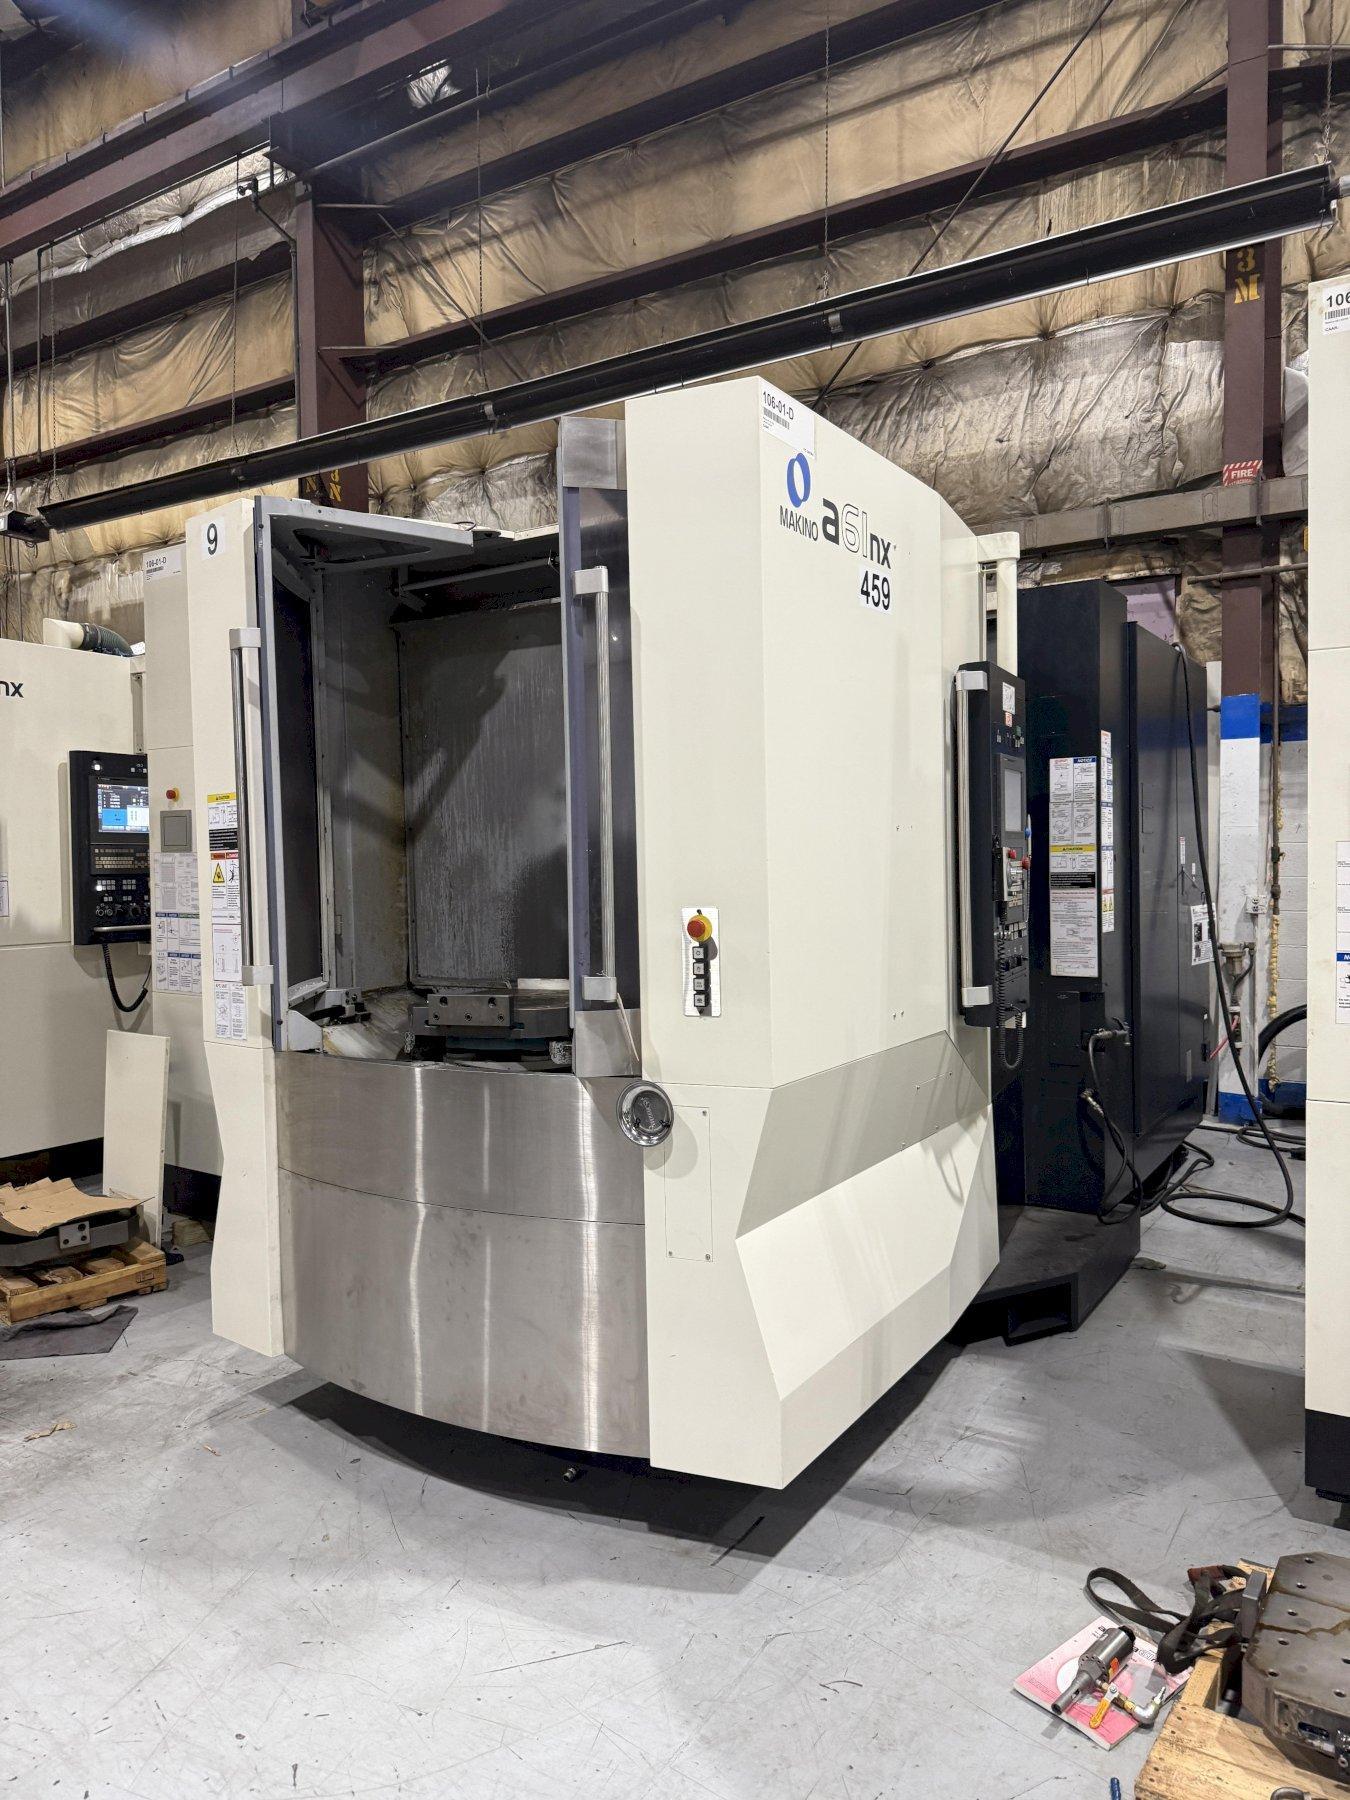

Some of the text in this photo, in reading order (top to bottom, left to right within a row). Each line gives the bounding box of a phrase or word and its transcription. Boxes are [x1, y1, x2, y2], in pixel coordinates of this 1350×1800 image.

[1234, 273, 1261, 304] M
[762, 391, 795, 421] 106-01-D
[1231, 468, 1254, 479] FIRE
[206, 522, 218, 555] 9
[779, 505, 819, 542] MAKINO
[860, 570, 891, 611] 459
